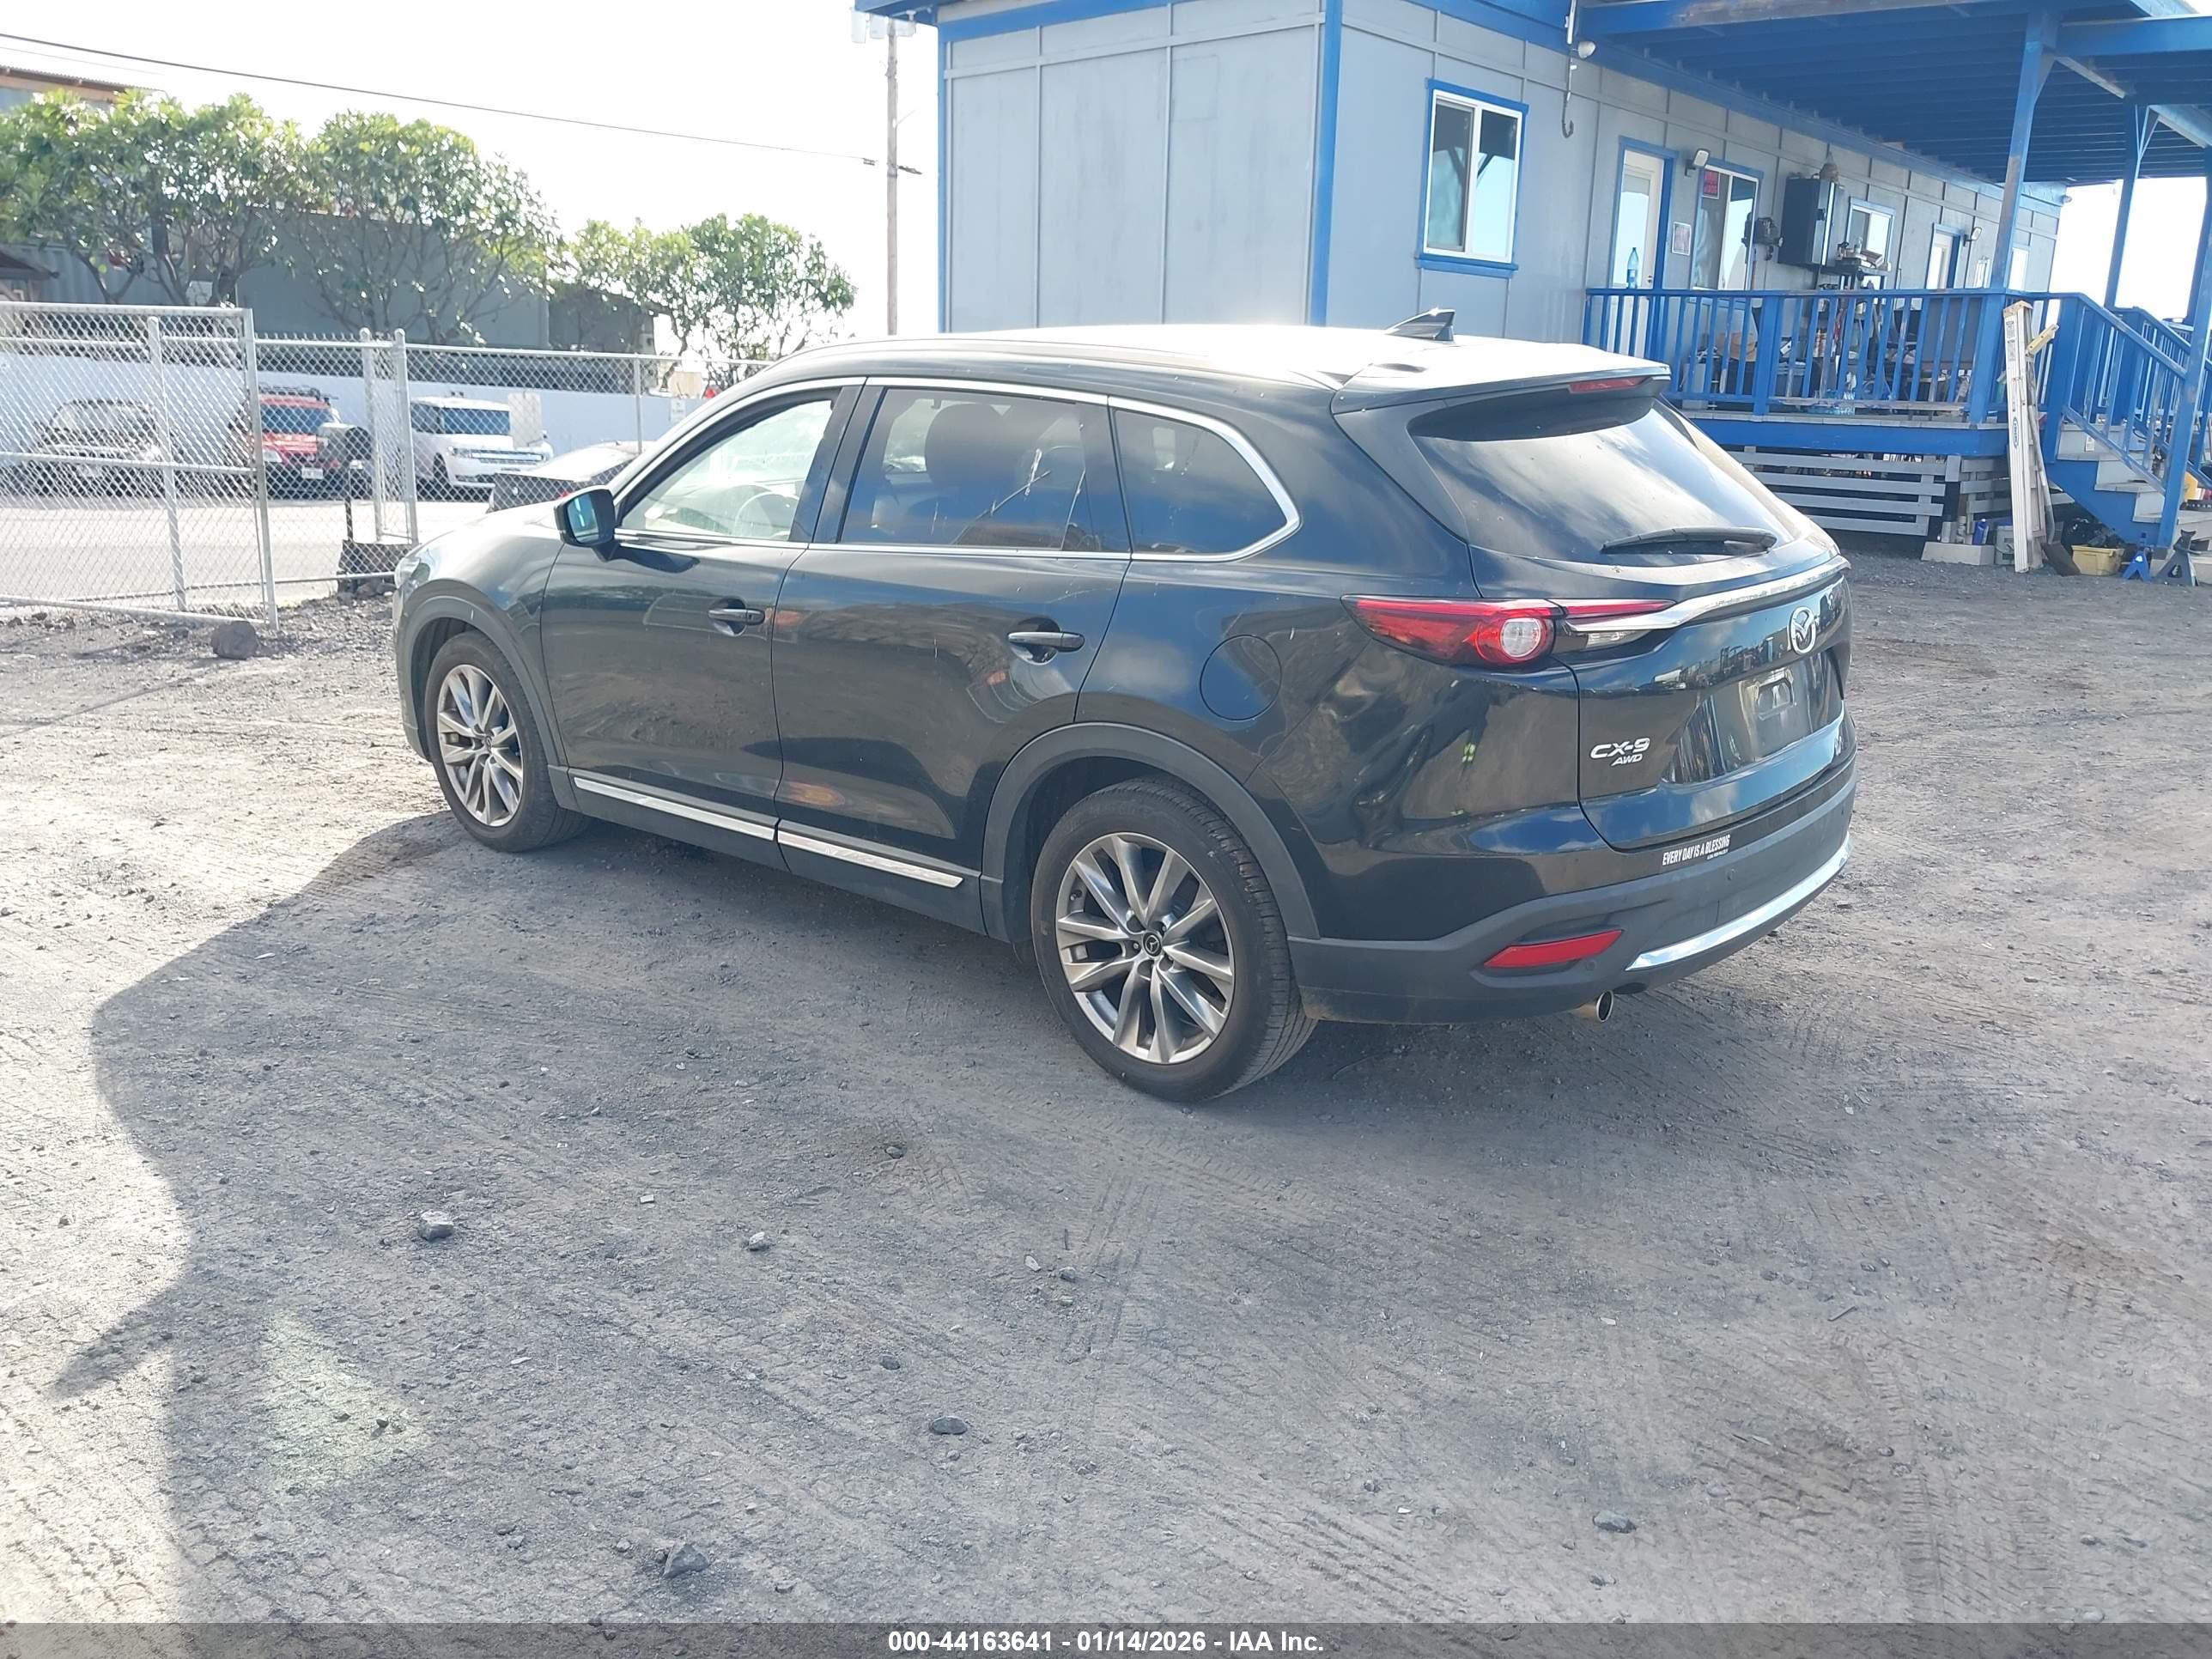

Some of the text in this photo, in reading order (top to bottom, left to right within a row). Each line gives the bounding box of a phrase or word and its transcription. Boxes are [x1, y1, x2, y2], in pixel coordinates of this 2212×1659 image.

[1590, 738, 1650, 758] CX-9
[1611, 754, 1643, 766] AWD
[1662, 849, 1683, 866] EVERY
[1682, 845, 1695, 861] DAY
[1693, 844, 1700, 858] IS
[1700, 843, 1705, 856] A
[1705, 835, 1731, 854] BLESSING
